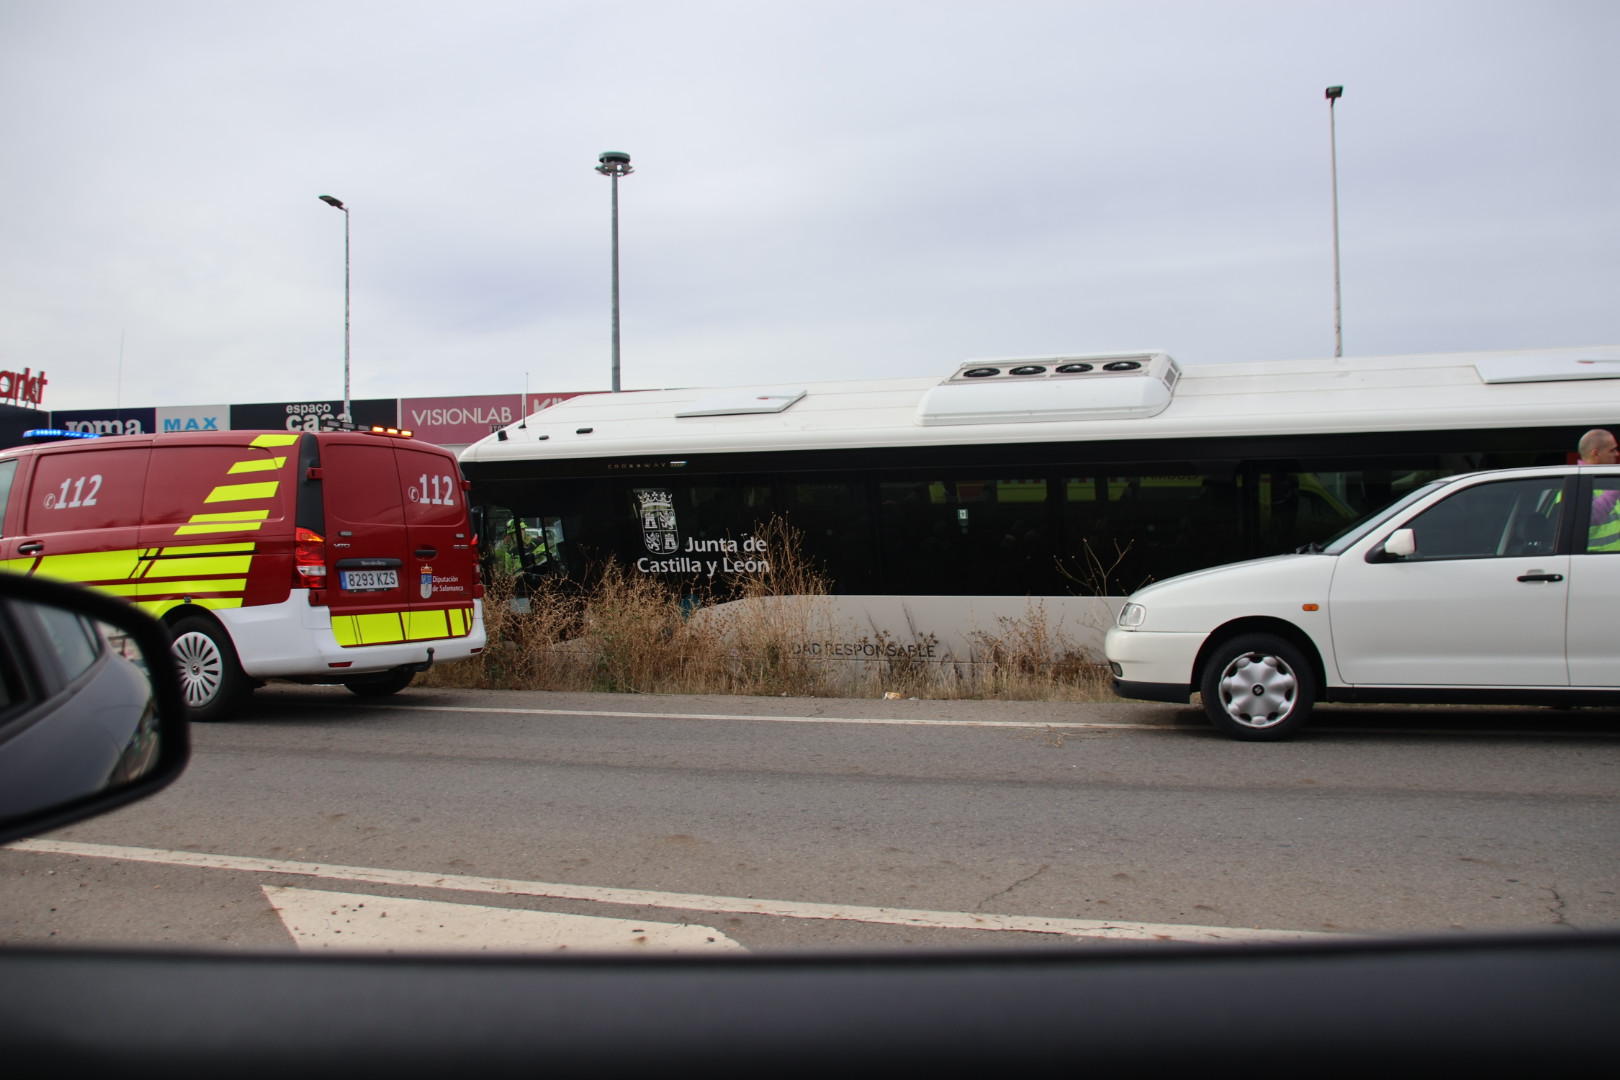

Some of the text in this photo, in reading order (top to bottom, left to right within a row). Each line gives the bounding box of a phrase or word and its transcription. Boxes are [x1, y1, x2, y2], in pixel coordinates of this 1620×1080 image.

[285, 403, 332, 416] espaço
[411, 406, 513, 427] VISIONLAB
[163, 416, 219, 431] MAX
[54, 474, 103, 510] 112
[418, 473, 455, 506] 112
[684, 536, 768, 553] Junta de
[636, 556, 771, 577] Castilla y León
[348, 571, 396, 587] 8293 KZS
[432, 575, 459, 584] Diputación
[439, 584, 464, 592] Salamanca
